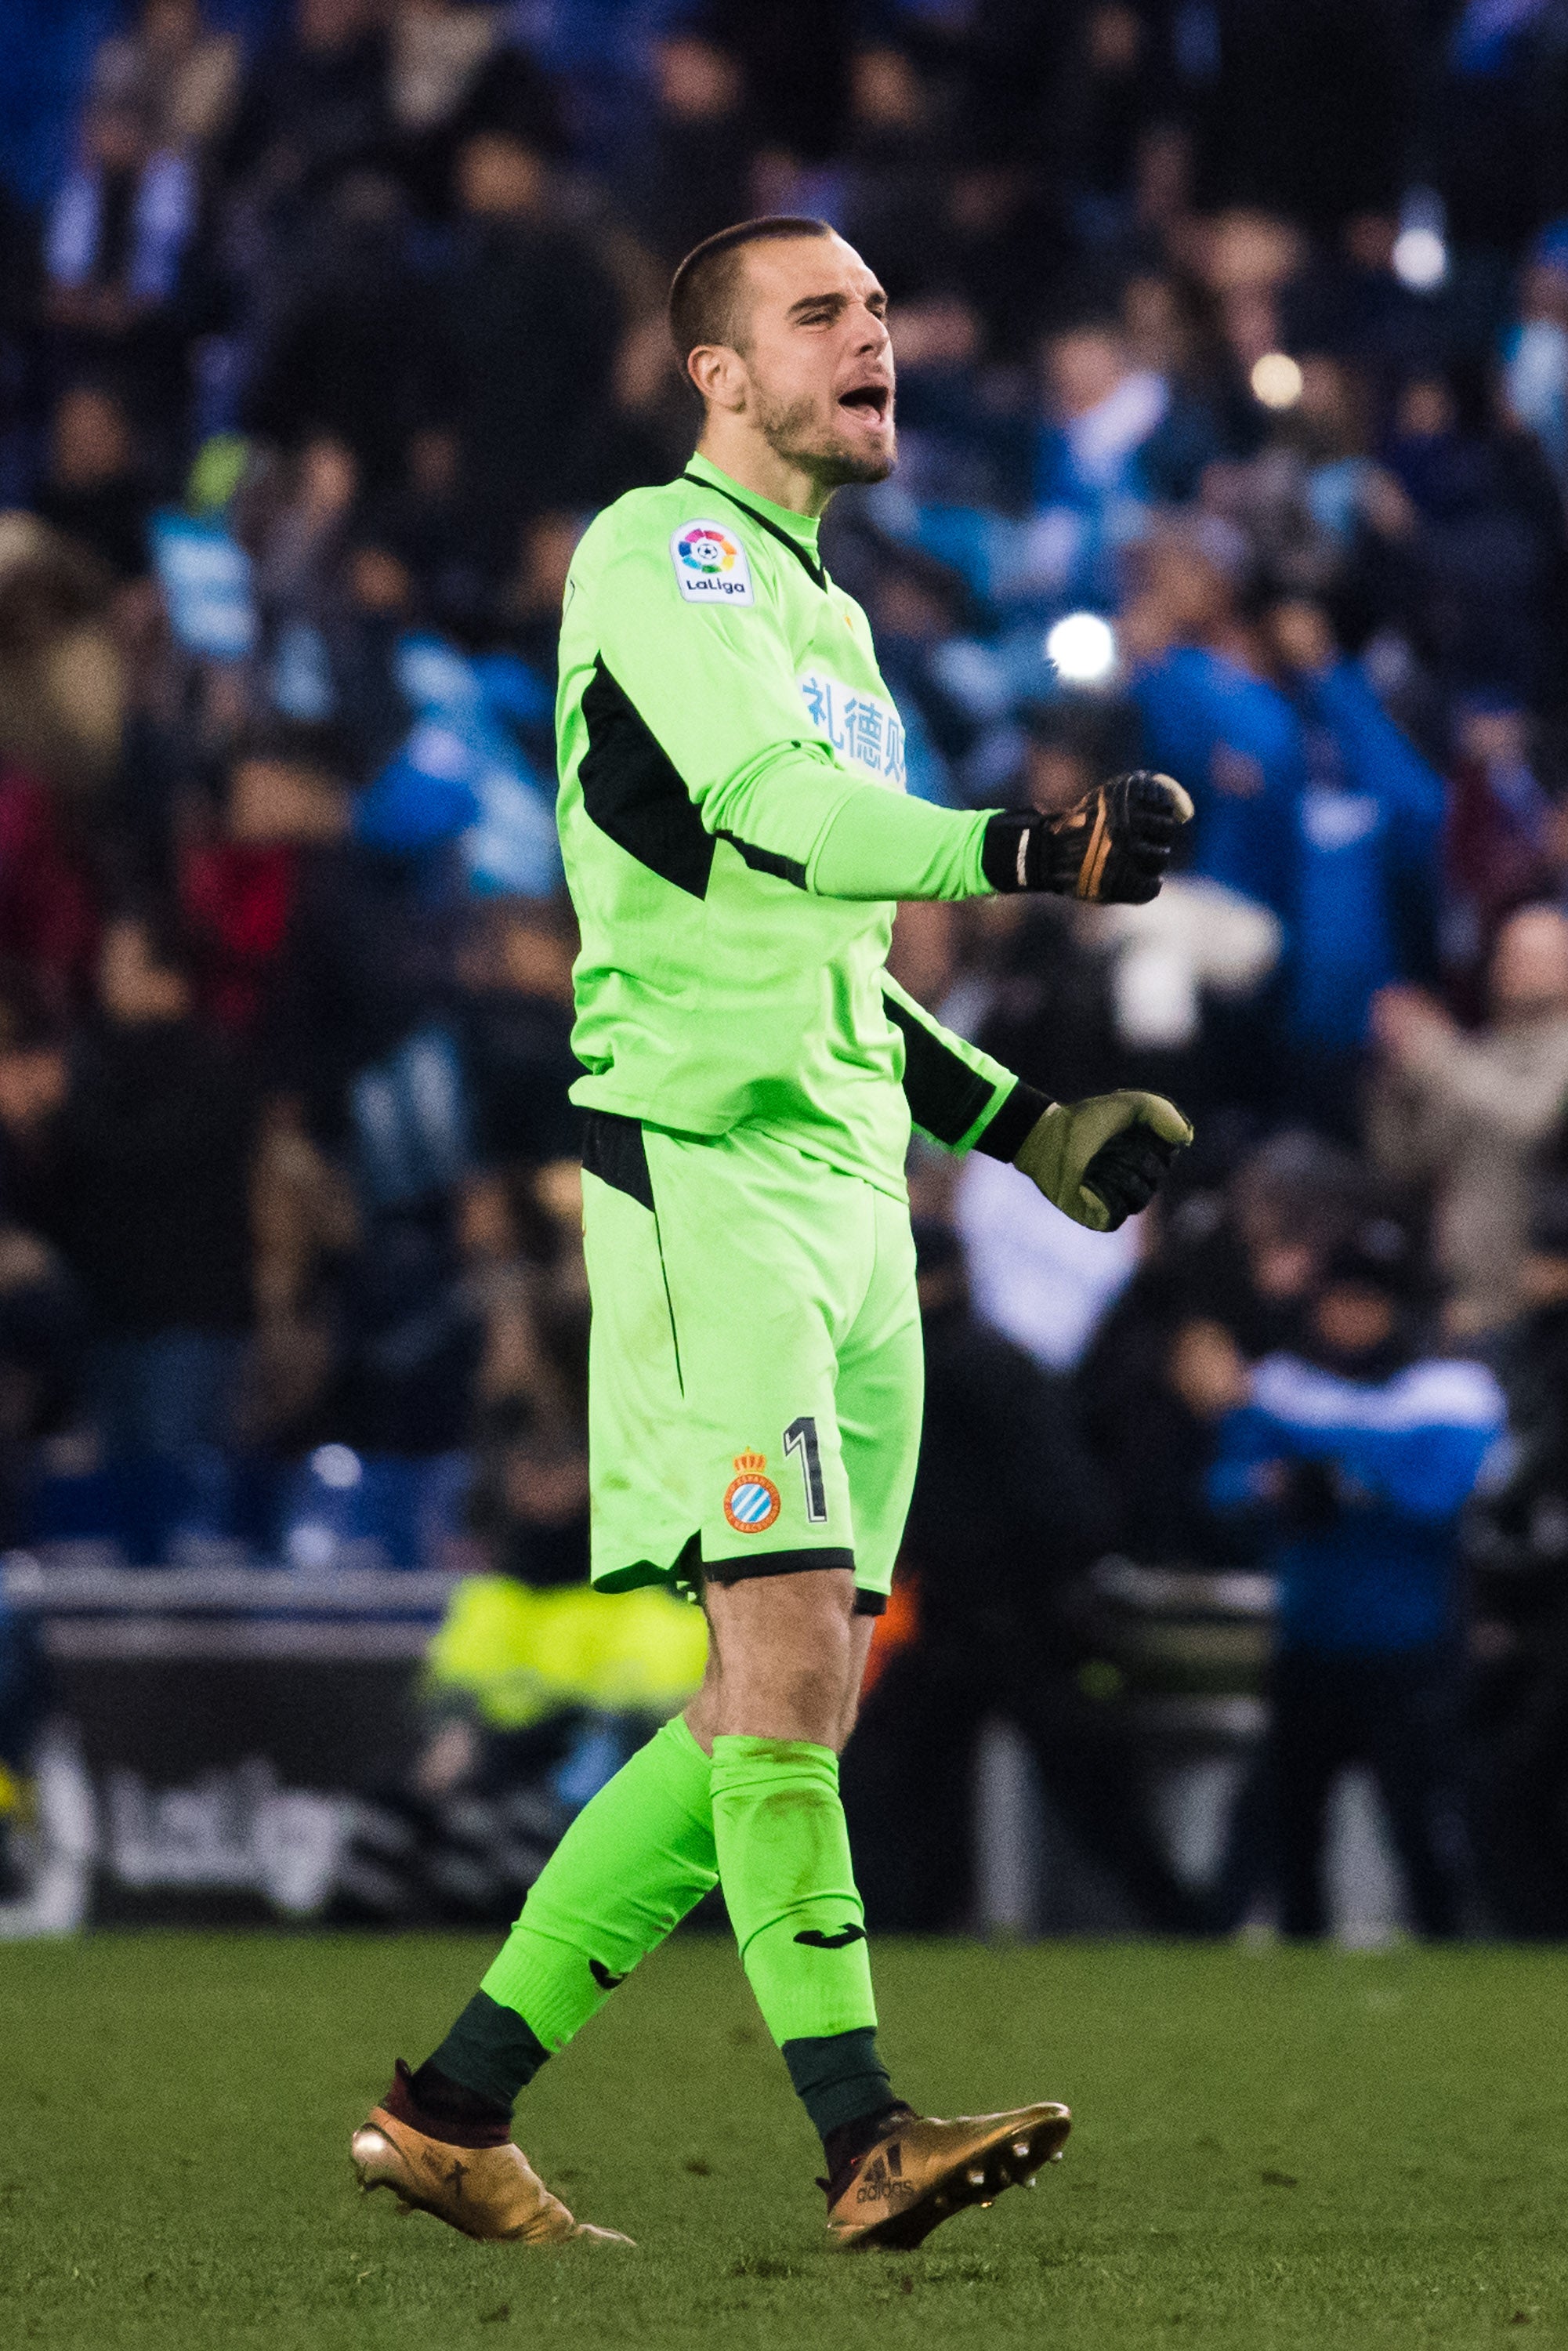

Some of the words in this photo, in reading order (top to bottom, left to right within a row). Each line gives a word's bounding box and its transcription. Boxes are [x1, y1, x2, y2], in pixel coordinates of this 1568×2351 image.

[686, 578, 746, 595] LaLiga
[783, 1416, 827, 1523] 1
[856, 2178, 914, 2204] adidas
